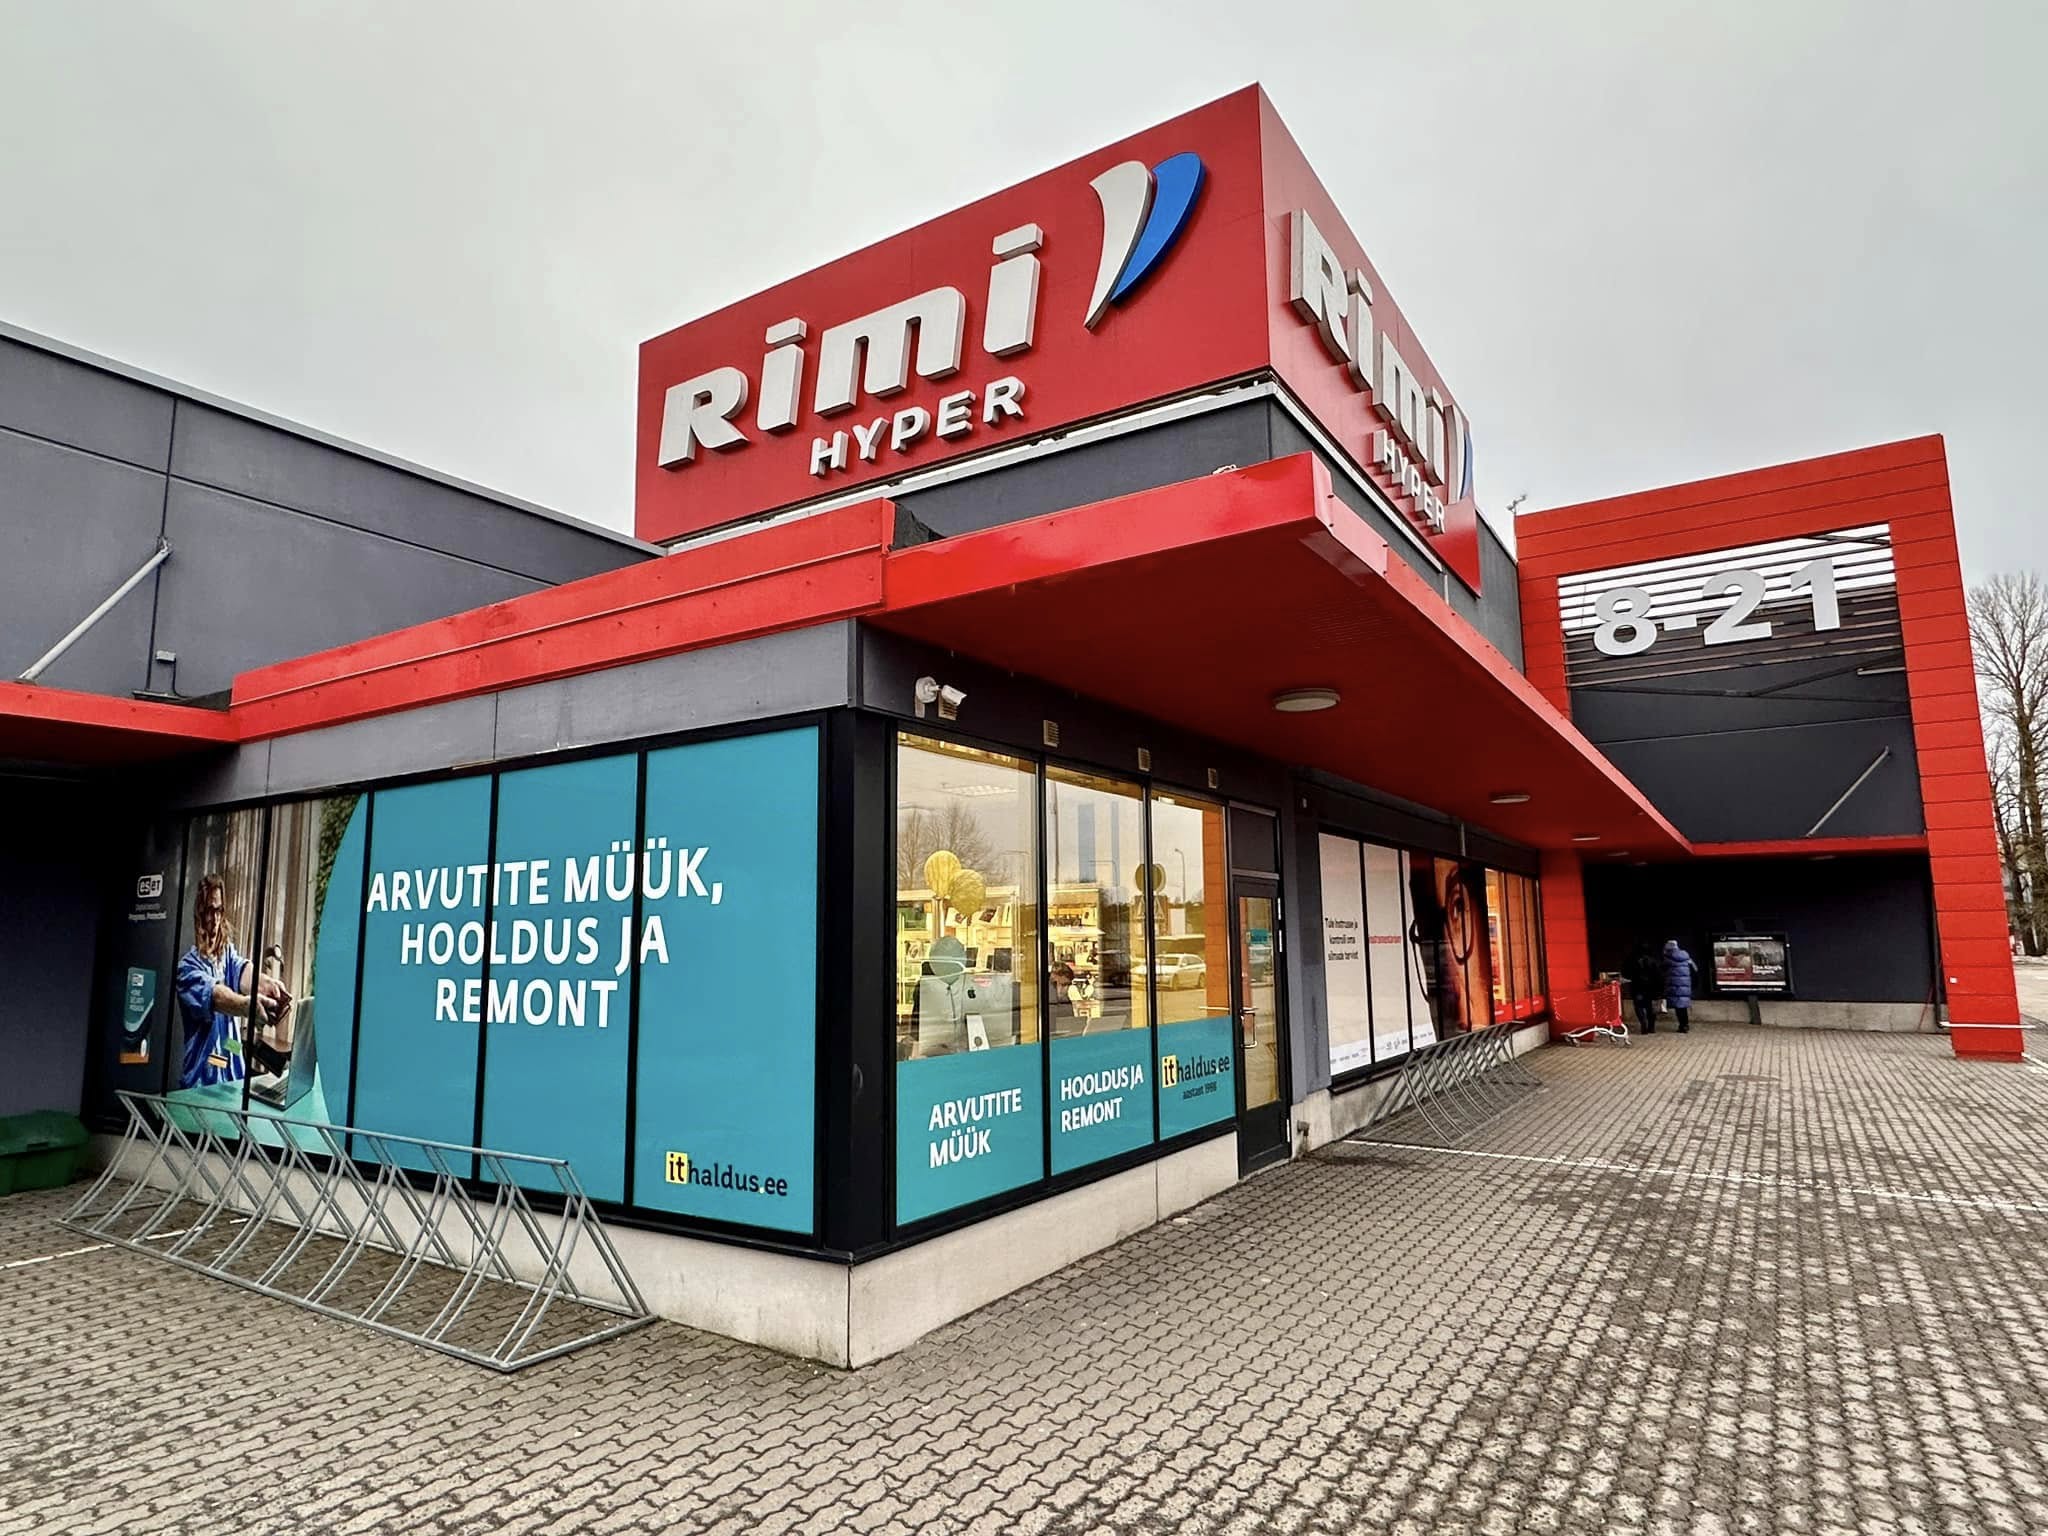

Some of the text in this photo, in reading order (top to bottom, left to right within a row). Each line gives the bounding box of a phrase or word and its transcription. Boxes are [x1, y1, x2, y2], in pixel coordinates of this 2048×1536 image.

[809, 376, 1026, 476] HYPER
[1373, 428, 1445, 534] HYPER
[1594, 558, 1841, 656] 8-21
[367, 836, 724, 913] ARVUTITE MÜÜK,
[400, 915, 670, 977] HOOLDUS JA
[435, 978, 618, 1028] REMONT
[1061, 1064, 1143, 1101] HOOLDUS JA
[1161, 1055, 1230, 1087] ithaldus.ee
[928, 1088, 1022, 1131] ARVUTITE
[1061, 1097, 1123, 1132] REMONT
[929, 1128, 992, 1169] MÜÜK
[667, 1152, 788, 1197] ithaldus.ee
